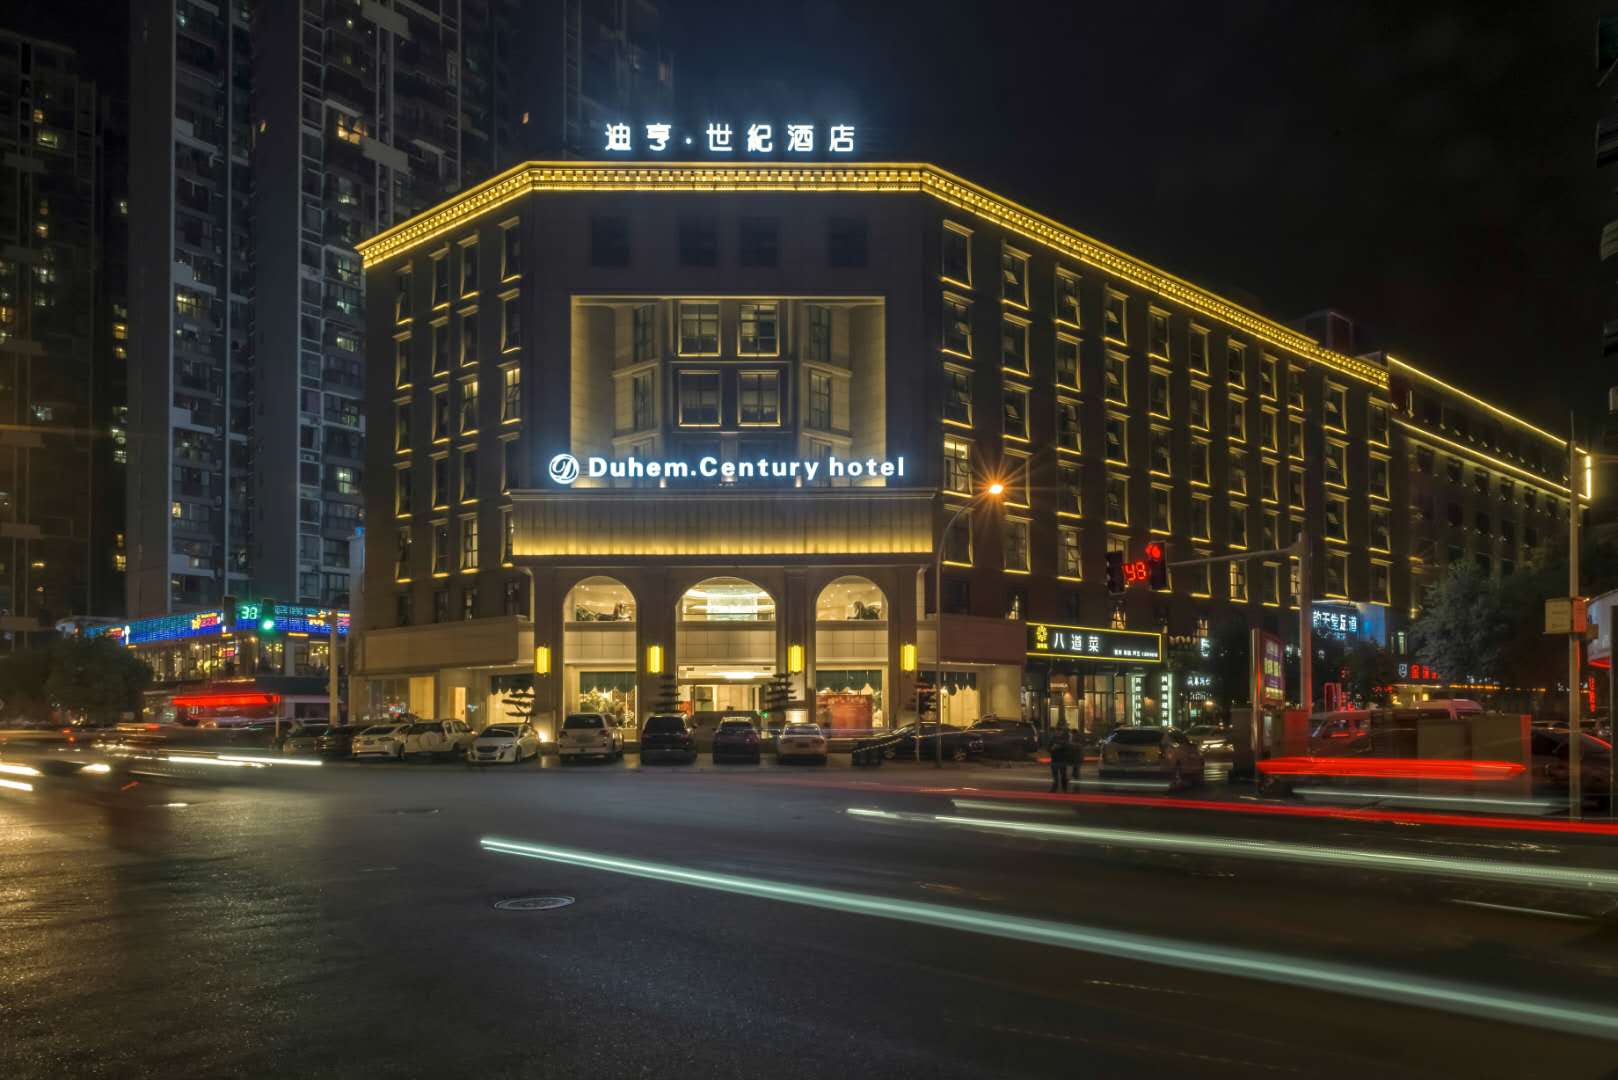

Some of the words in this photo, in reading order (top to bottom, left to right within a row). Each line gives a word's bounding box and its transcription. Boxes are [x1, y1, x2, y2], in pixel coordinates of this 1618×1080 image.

[589, 456, 819, 479] Duhem.Century
[829, 456, 905, 478] hotel
[1053, 631, 1100, 653] 八道菜
